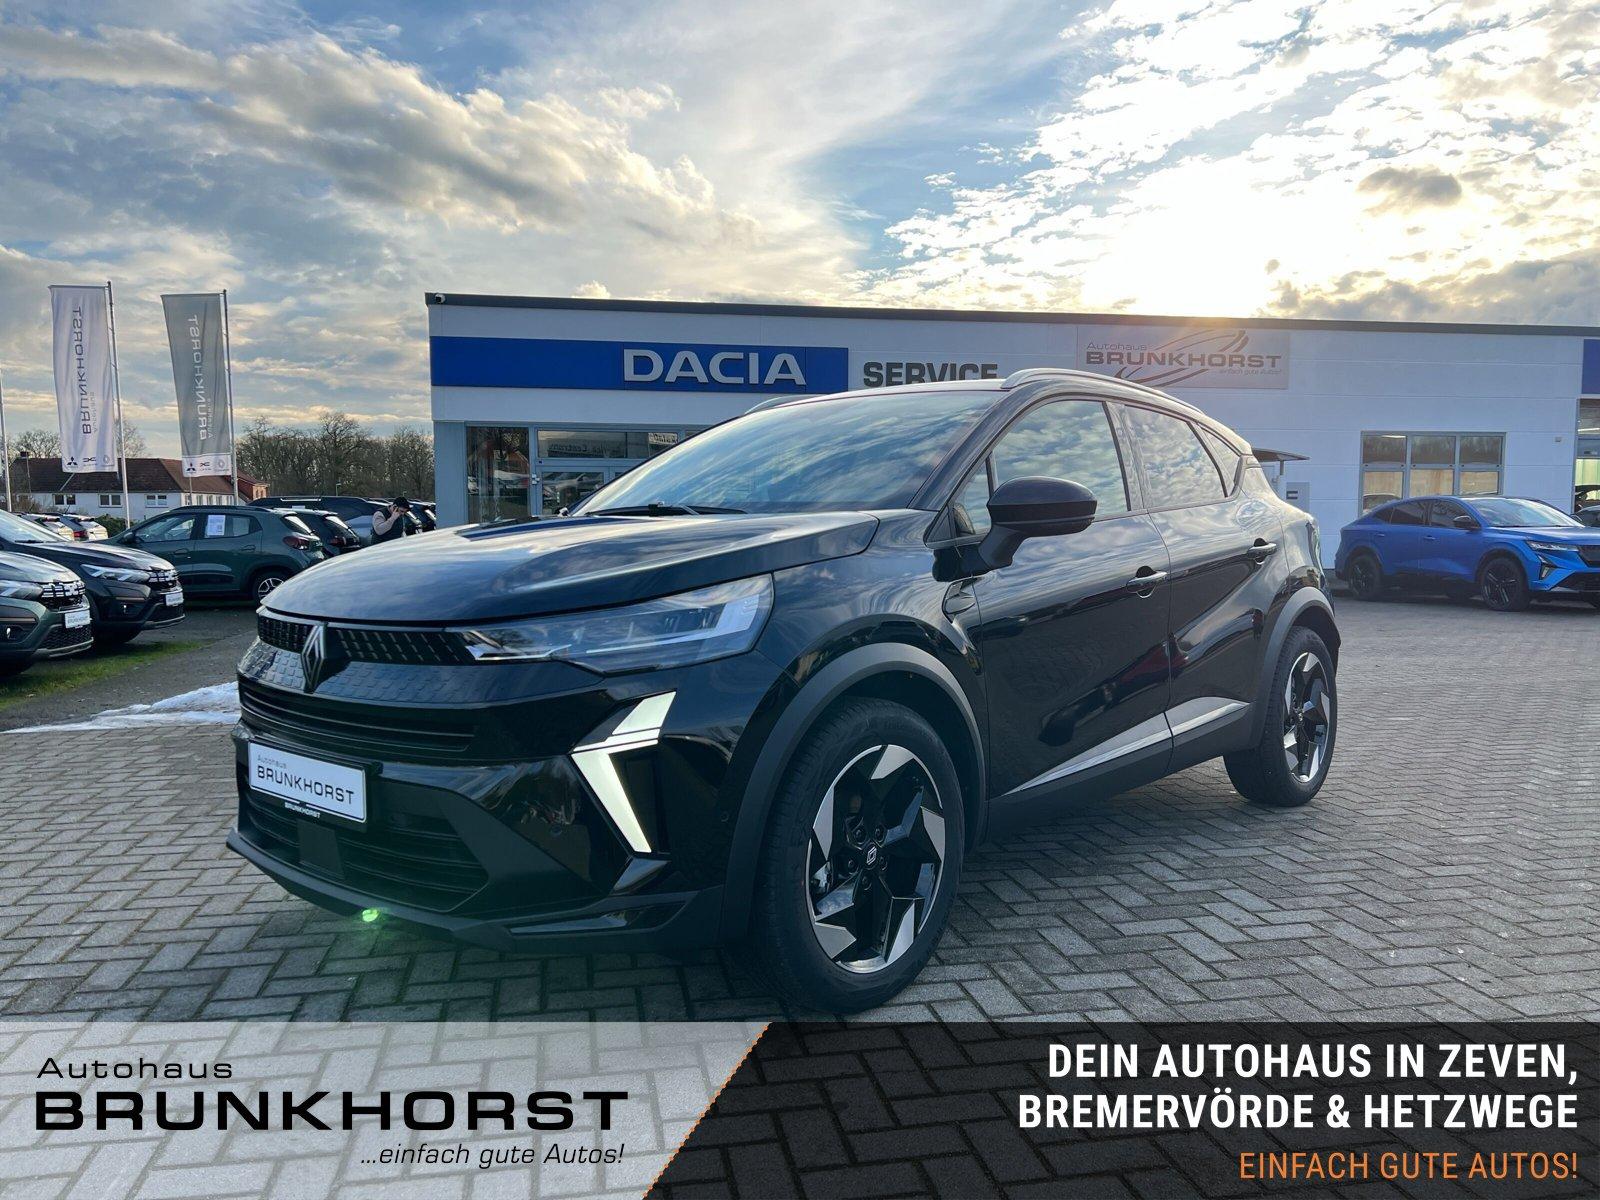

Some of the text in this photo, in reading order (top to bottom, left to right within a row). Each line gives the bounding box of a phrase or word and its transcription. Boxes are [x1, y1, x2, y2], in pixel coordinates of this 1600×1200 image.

[1086, 341, 1148, 351] Autohaus
[1086, 351, 1282, 368] BRUNKHORST
[624, 349, 807, 386] DACIA
[257, 765, 355, 805] BRUNKHORST
